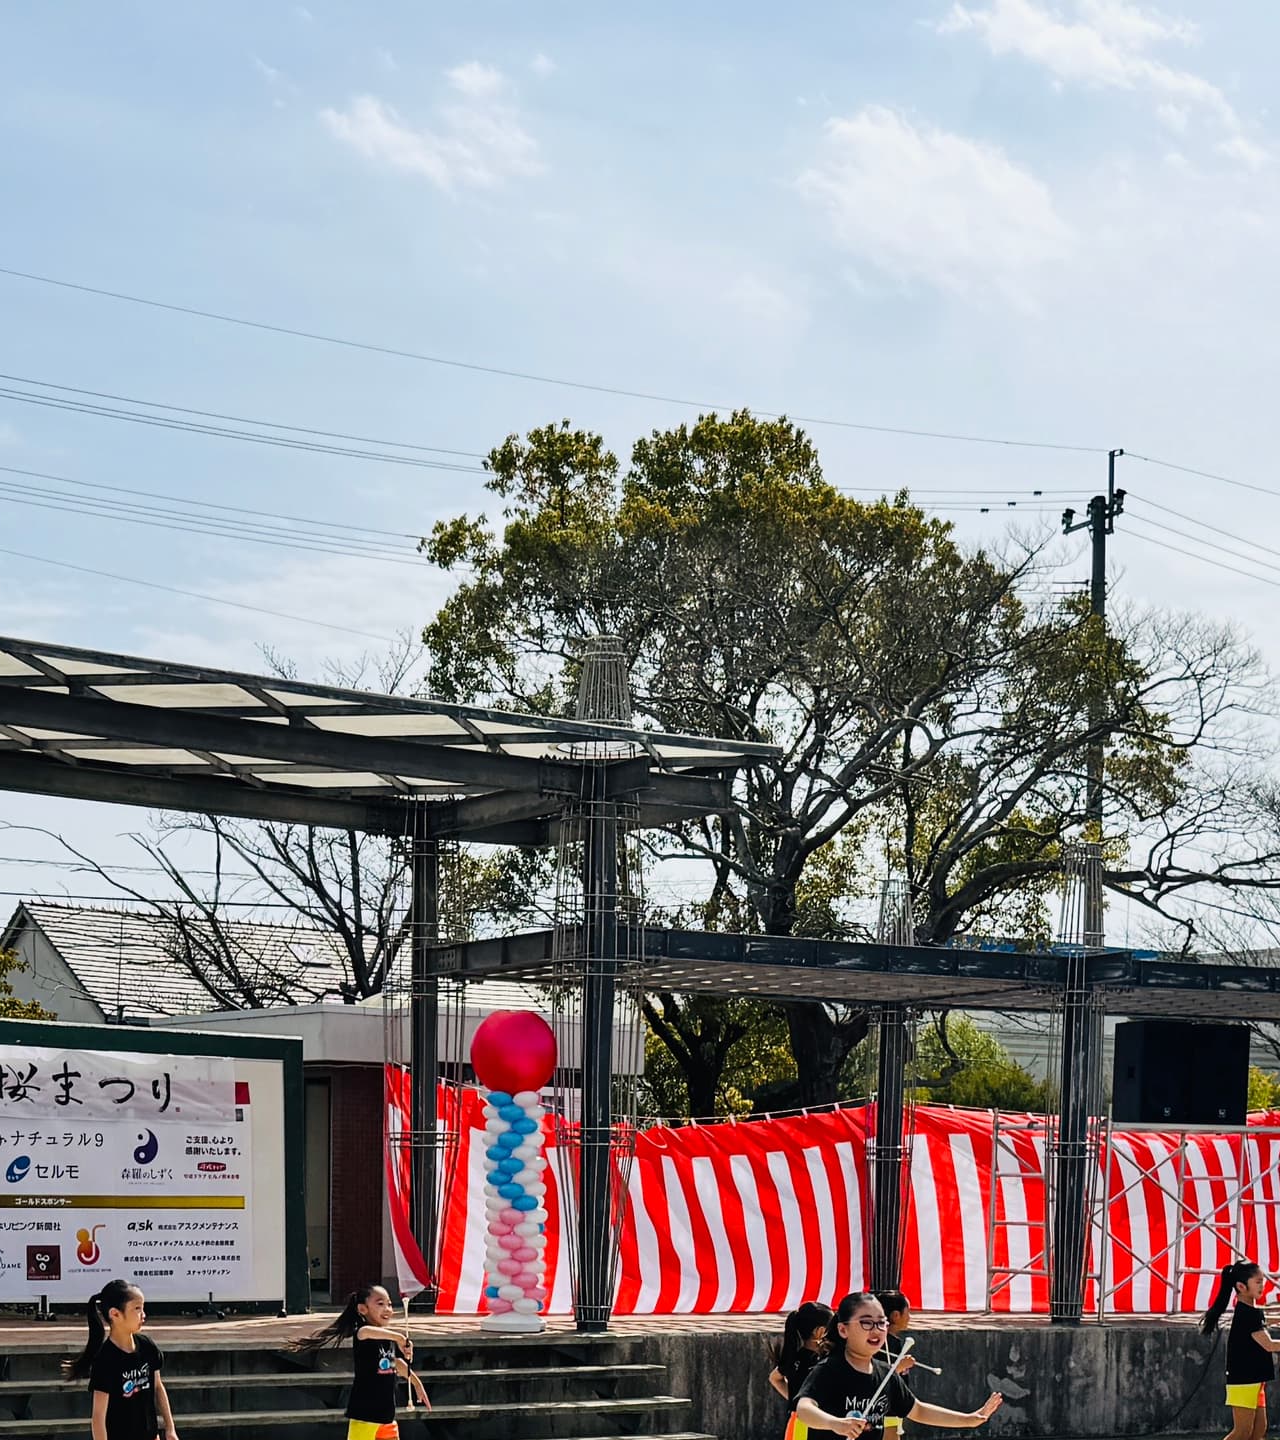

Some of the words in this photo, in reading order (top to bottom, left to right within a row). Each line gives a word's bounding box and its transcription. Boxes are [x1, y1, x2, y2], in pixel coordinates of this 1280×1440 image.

[10, 1130, 104, 1149] ナチュラル9
[35, 1163, 80, 1180] セルモ
[15, 1197, 72, 1206] ゴールドスポンサー
